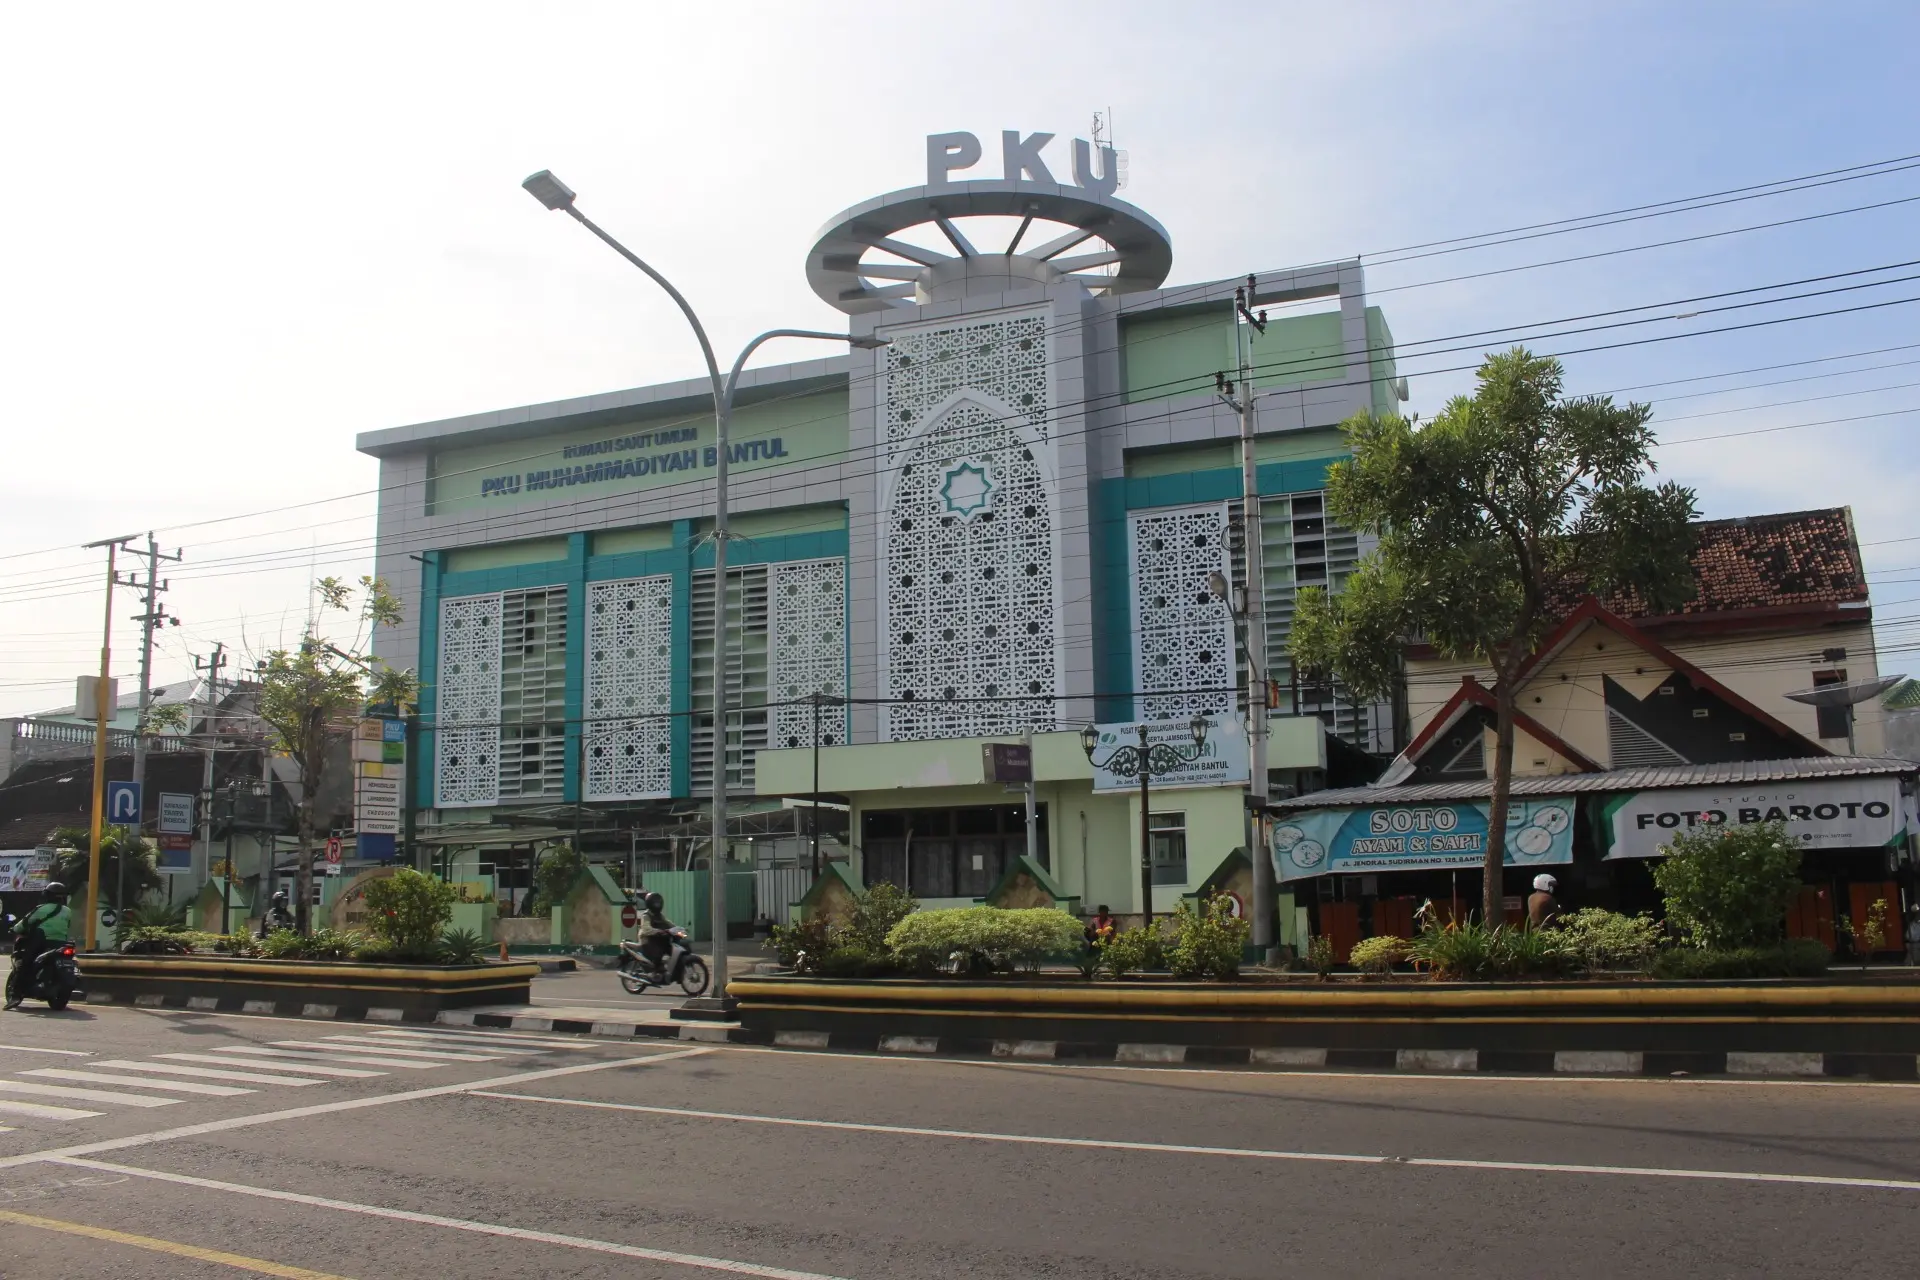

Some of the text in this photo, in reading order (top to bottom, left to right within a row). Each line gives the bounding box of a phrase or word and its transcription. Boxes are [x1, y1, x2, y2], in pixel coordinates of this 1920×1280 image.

[926, 131, 1118, 197] PKU
[563, 427, 698, 459] RUMAH SAKIT UMUM
[481, 438, 788, 497] PKU MUHAMMADIYAH BANTUL
[1120, 726, 1135, 735] PUSAT
[1165, 733, 1194, 741] JAMSOSTE
[1201, 760, 1230, 771] BANTUL
[1713, 794, 1796, 805] STUDIO
[1370, 807, 1458, 834] SOTO
[1636, 801, 1890, 830] FOTO BAROTO
[1350, 833, 1480, 855] AYAM & SAPI
[1388, 857, 1430, 865] SUDIRMAN
[1459, 854, 1486, 863] BANTU
